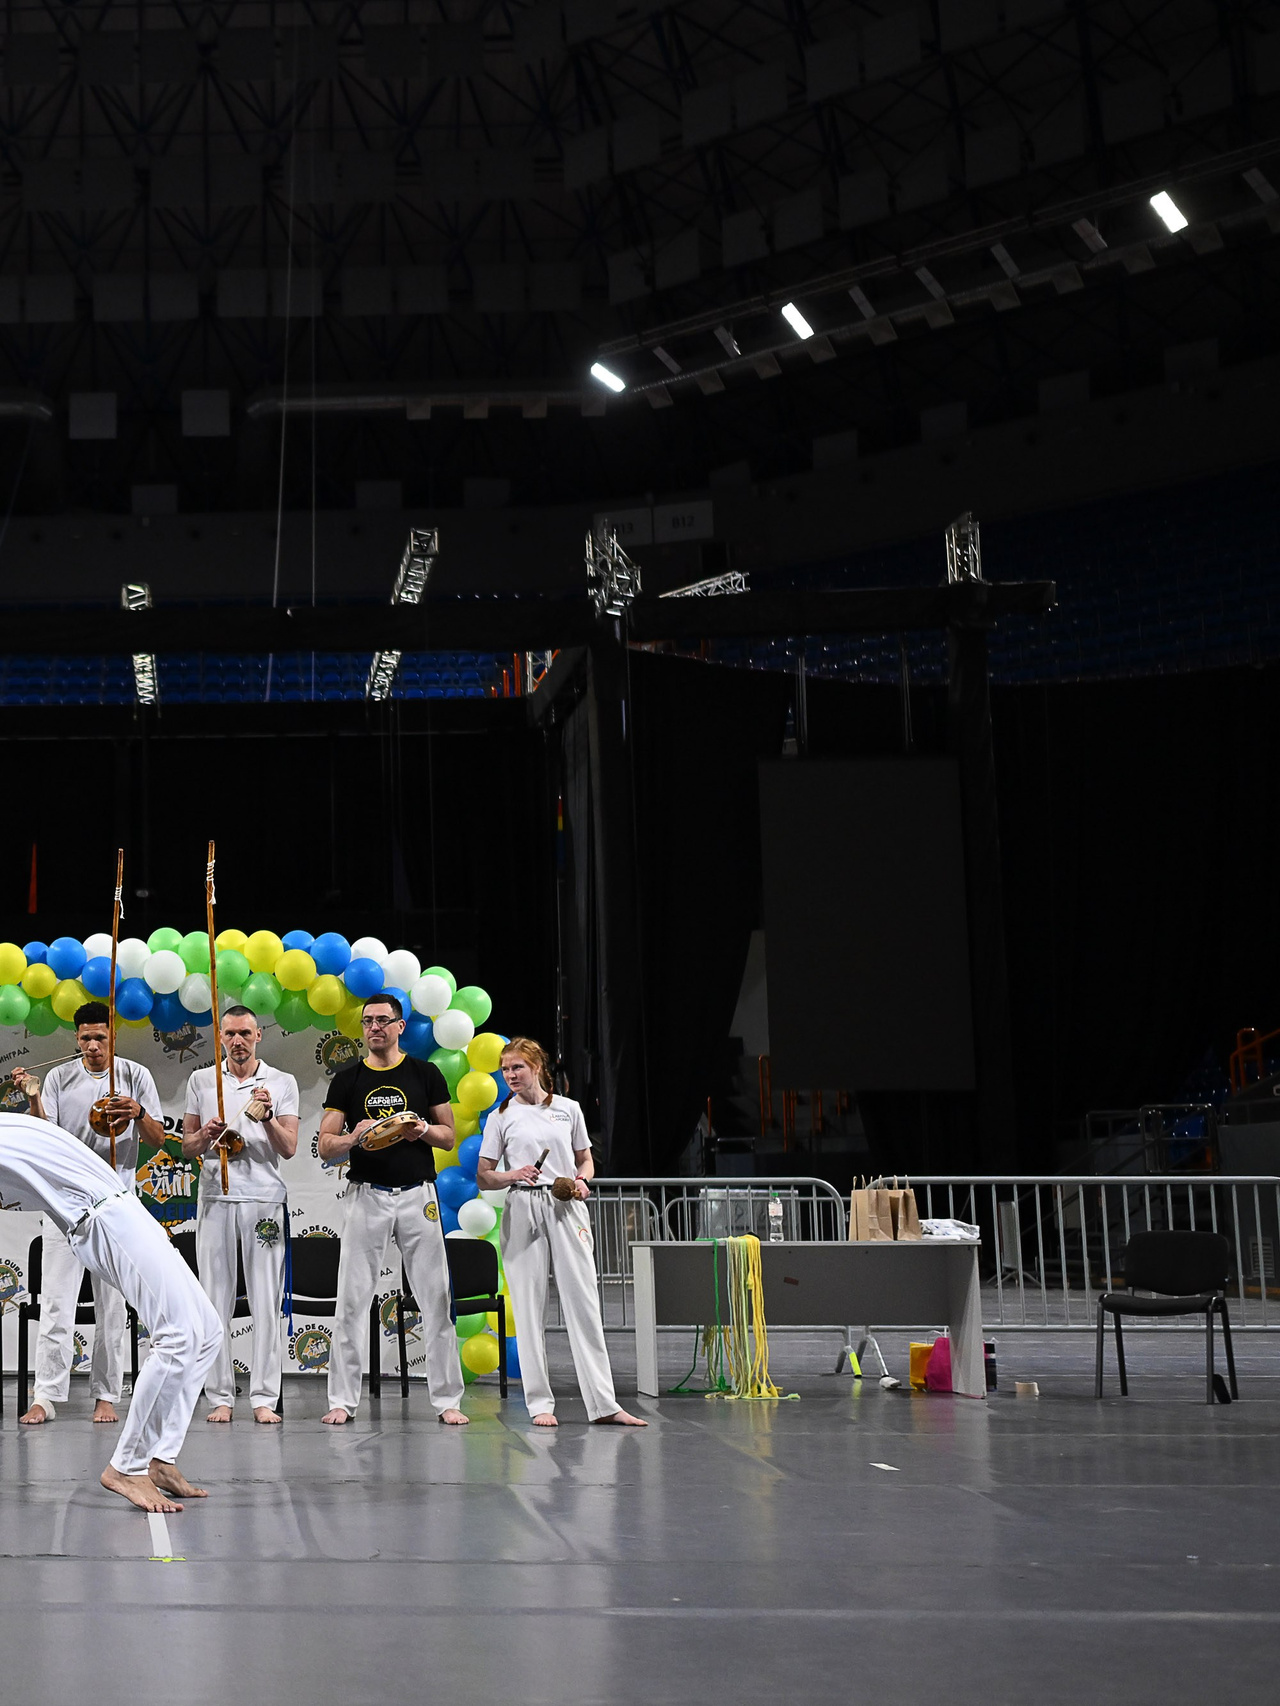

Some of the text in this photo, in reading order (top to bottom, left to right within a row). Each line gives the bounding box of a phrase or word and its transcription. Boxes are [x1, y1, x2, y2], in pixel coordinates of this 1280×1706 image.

[367, 1097, 404, 1105] CAPOEIRA
[309, 1224, 320, 1232] DE
[5, 1259, 23, 1277] OURO
[305, 1323, 316, 1331] DE
[74, 1330, 88, 1347] URO
